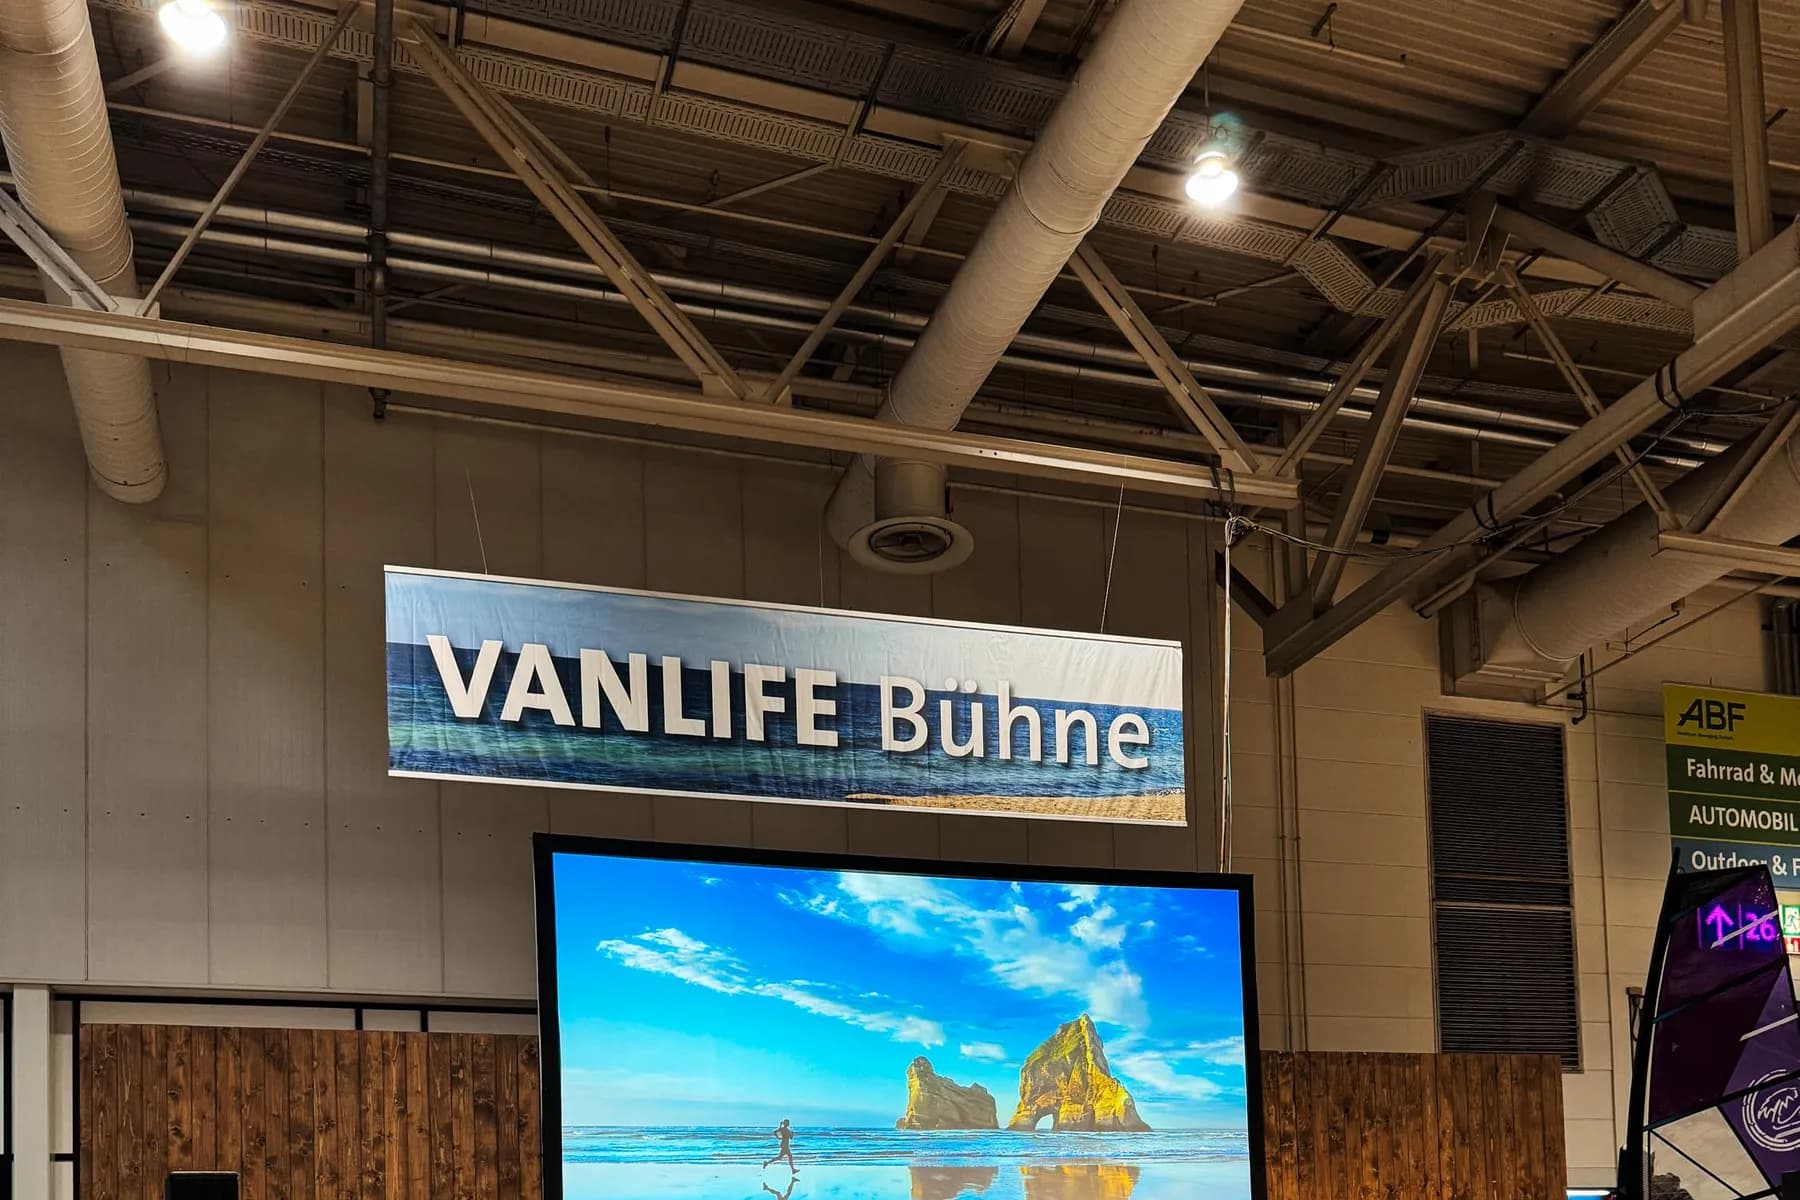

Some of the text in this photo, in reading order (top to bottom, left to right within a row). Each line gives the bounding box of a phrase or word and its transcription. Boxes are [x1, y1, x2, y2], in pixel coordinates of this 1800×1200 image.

[427, 634, 1151, 769] VANLIFE Bühne
[1677, 699, 1746, 732] ABF
[1687, 758, 1754, 783] Fahrrad
[1760, 763, 1775, 784] &
[1689, 804, 1799, 832] AUTOMOBIL
[1772, 855, 1788, 876] &
[1745, 911, 1777, 942] 26
